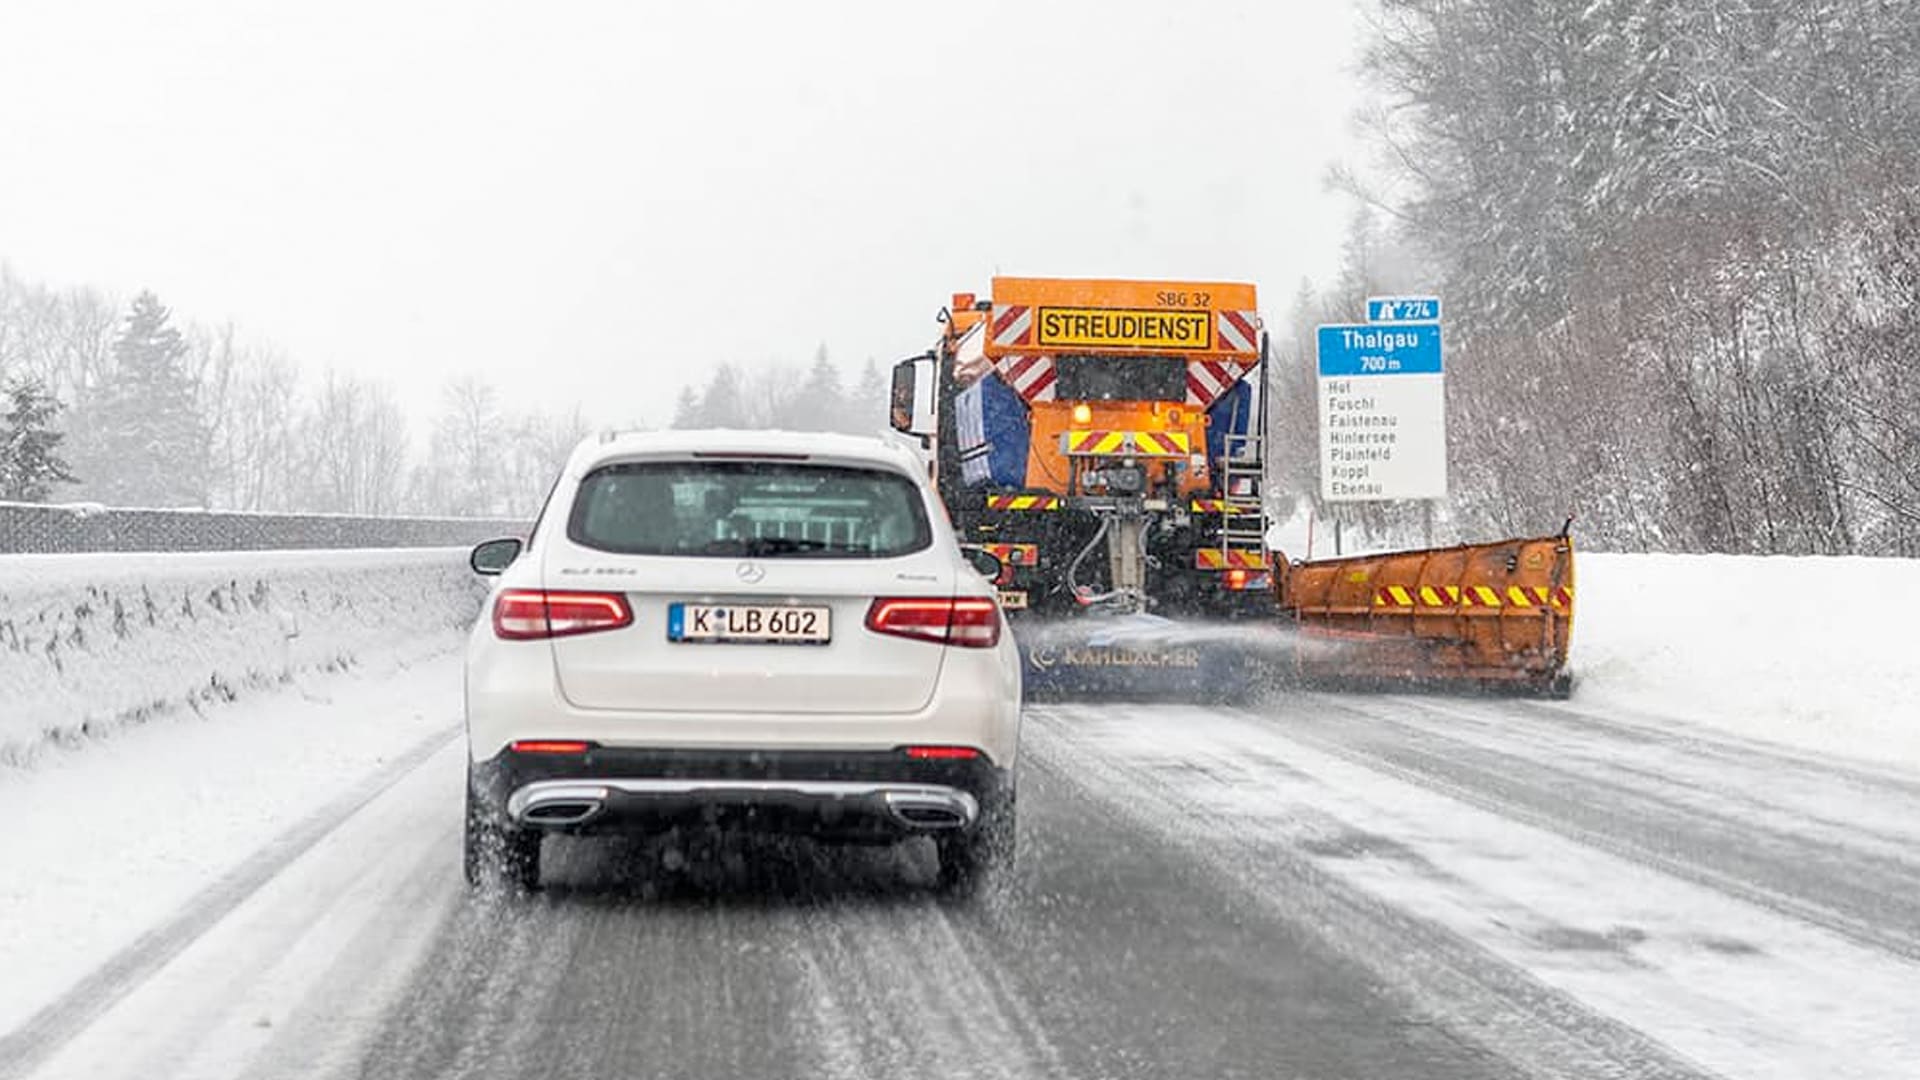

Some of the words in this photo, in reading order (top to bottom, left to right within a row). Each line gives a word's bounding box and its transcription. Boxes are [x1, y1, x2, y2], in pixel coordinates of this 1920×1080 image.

[1157, 292, 1187, 306] SBG
[1194, 293, 1210, 307] 32
[1404, 303, 1431, 318] 274
[1045, 314, 1204, 340] STREUDIENST
[1342, 331, 1418, 352] Thalgau
[1361, 357, 1386, 371] 700
[1389, 361, 1401, 370] m
[1329, 397, 1374, 410] Fuschl
[1330, 414, 1397, 426] Faistenau
[1331, 430, 1396, 443] Hintersee
[1331, 447, 1390, 461] Plainfeld
[1331, 464, 1369, 479] Koppl
[1332, 481, 1382, 495] Ebenau
[694, 609, 710, 632] K
[729, 610, 762, 633] LB
[769, 612, 816, 634] 602
